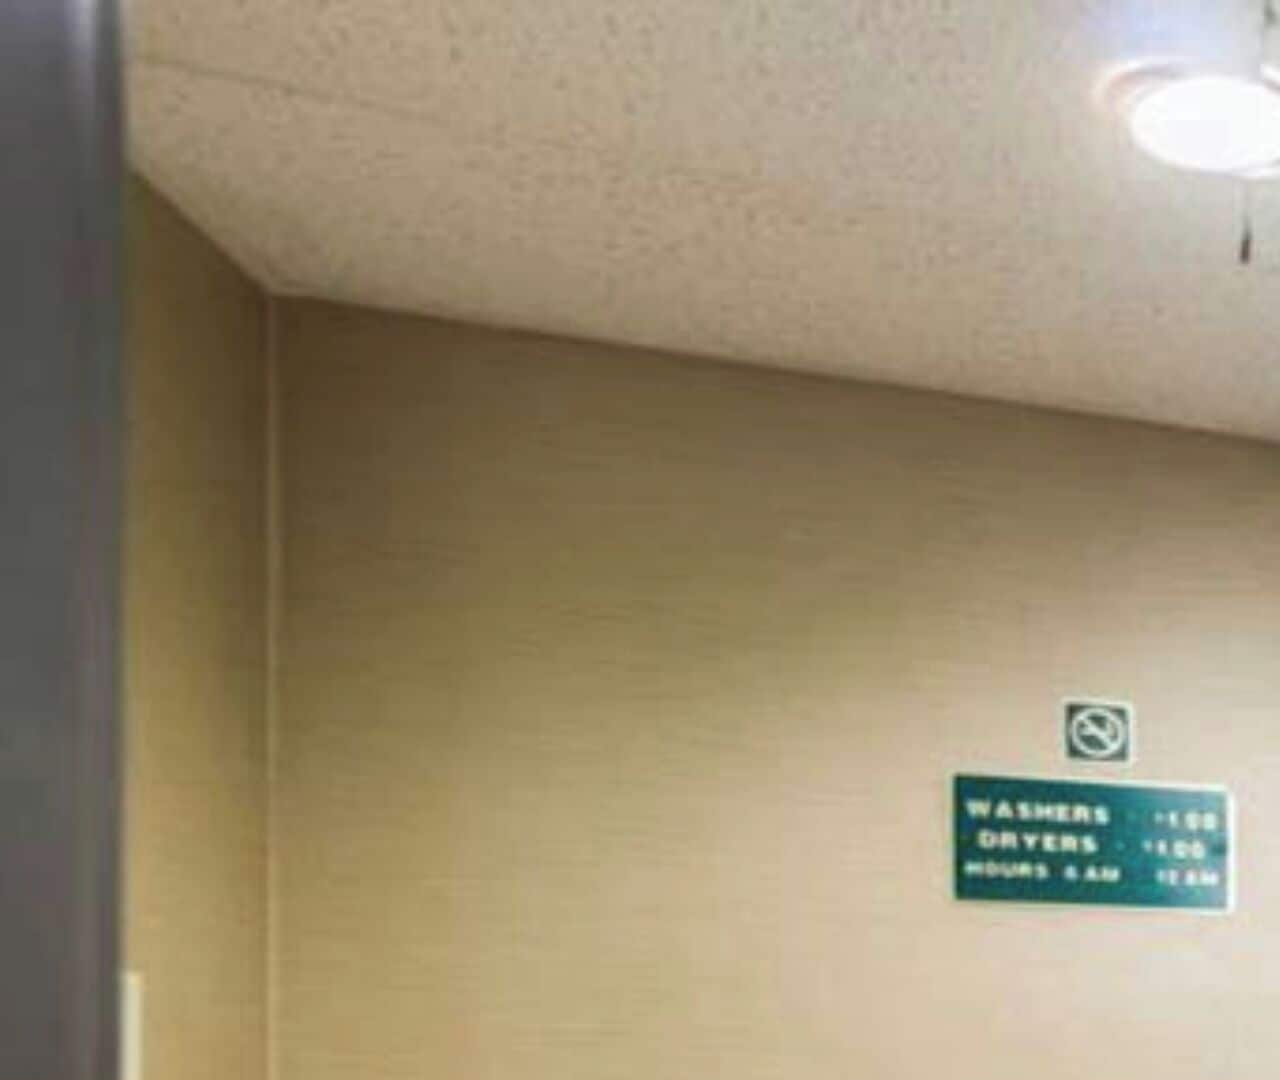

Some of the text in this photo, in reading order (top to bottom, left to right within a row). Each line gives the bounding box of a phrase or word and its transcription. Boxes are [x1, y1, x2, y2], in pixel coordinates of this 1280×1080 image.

[966, 800, 1110, 827] WASHERS
[977, 829, 1099, 856] DRYERS
[964, 860, 1049, 882] HOURS
